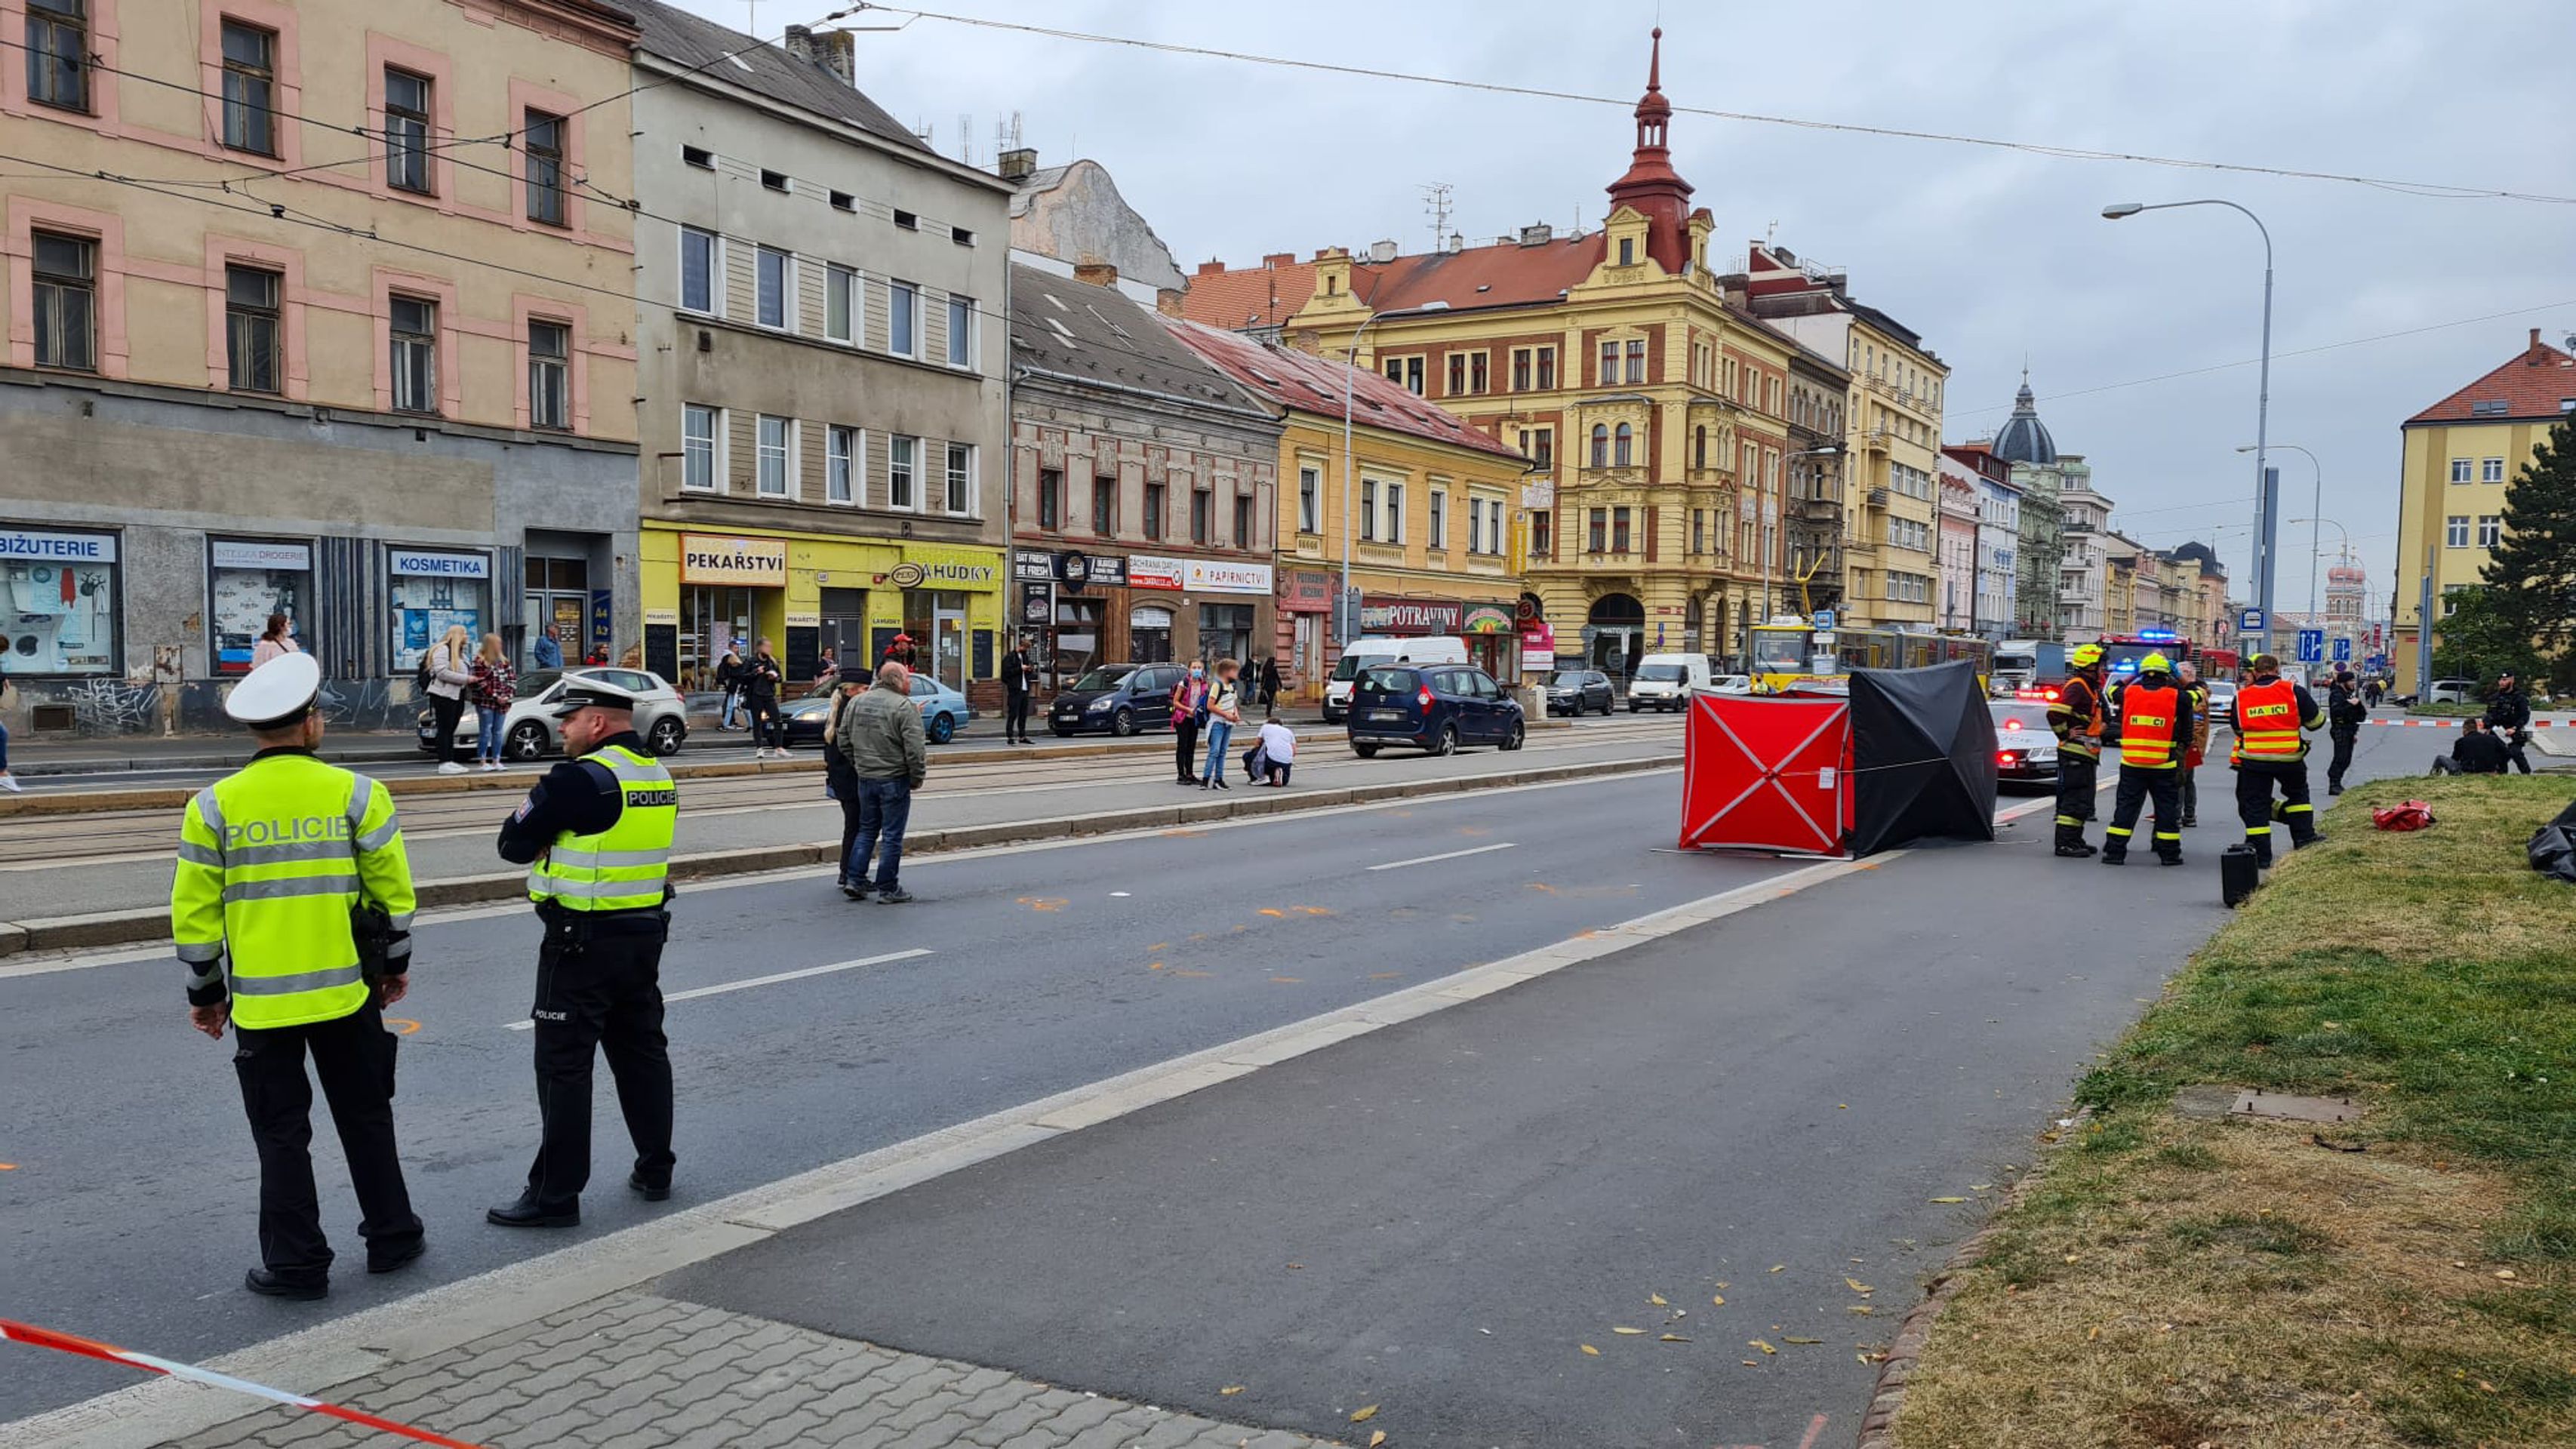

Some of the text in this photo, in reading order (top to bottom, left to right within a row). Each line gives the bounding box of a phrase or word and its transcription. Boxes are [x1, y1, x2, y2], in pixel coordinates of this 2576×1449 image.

[0, 534, 99, 556] BIŽUTERIE
[400, 558, 482, 573] KOSMETIKA
[687, 552, 783, 571] PEKAŘSTVÍ
[1210, 568, 1265, 584] PAPÍRNICTVÍ
[1390, 606, 1457, 626] POTRAVINY
[628, 791, 677, 805] POLICIE
[225, 817, 349, 848] POLICIE
[536, 1009, 567, 1020] POLICIE
